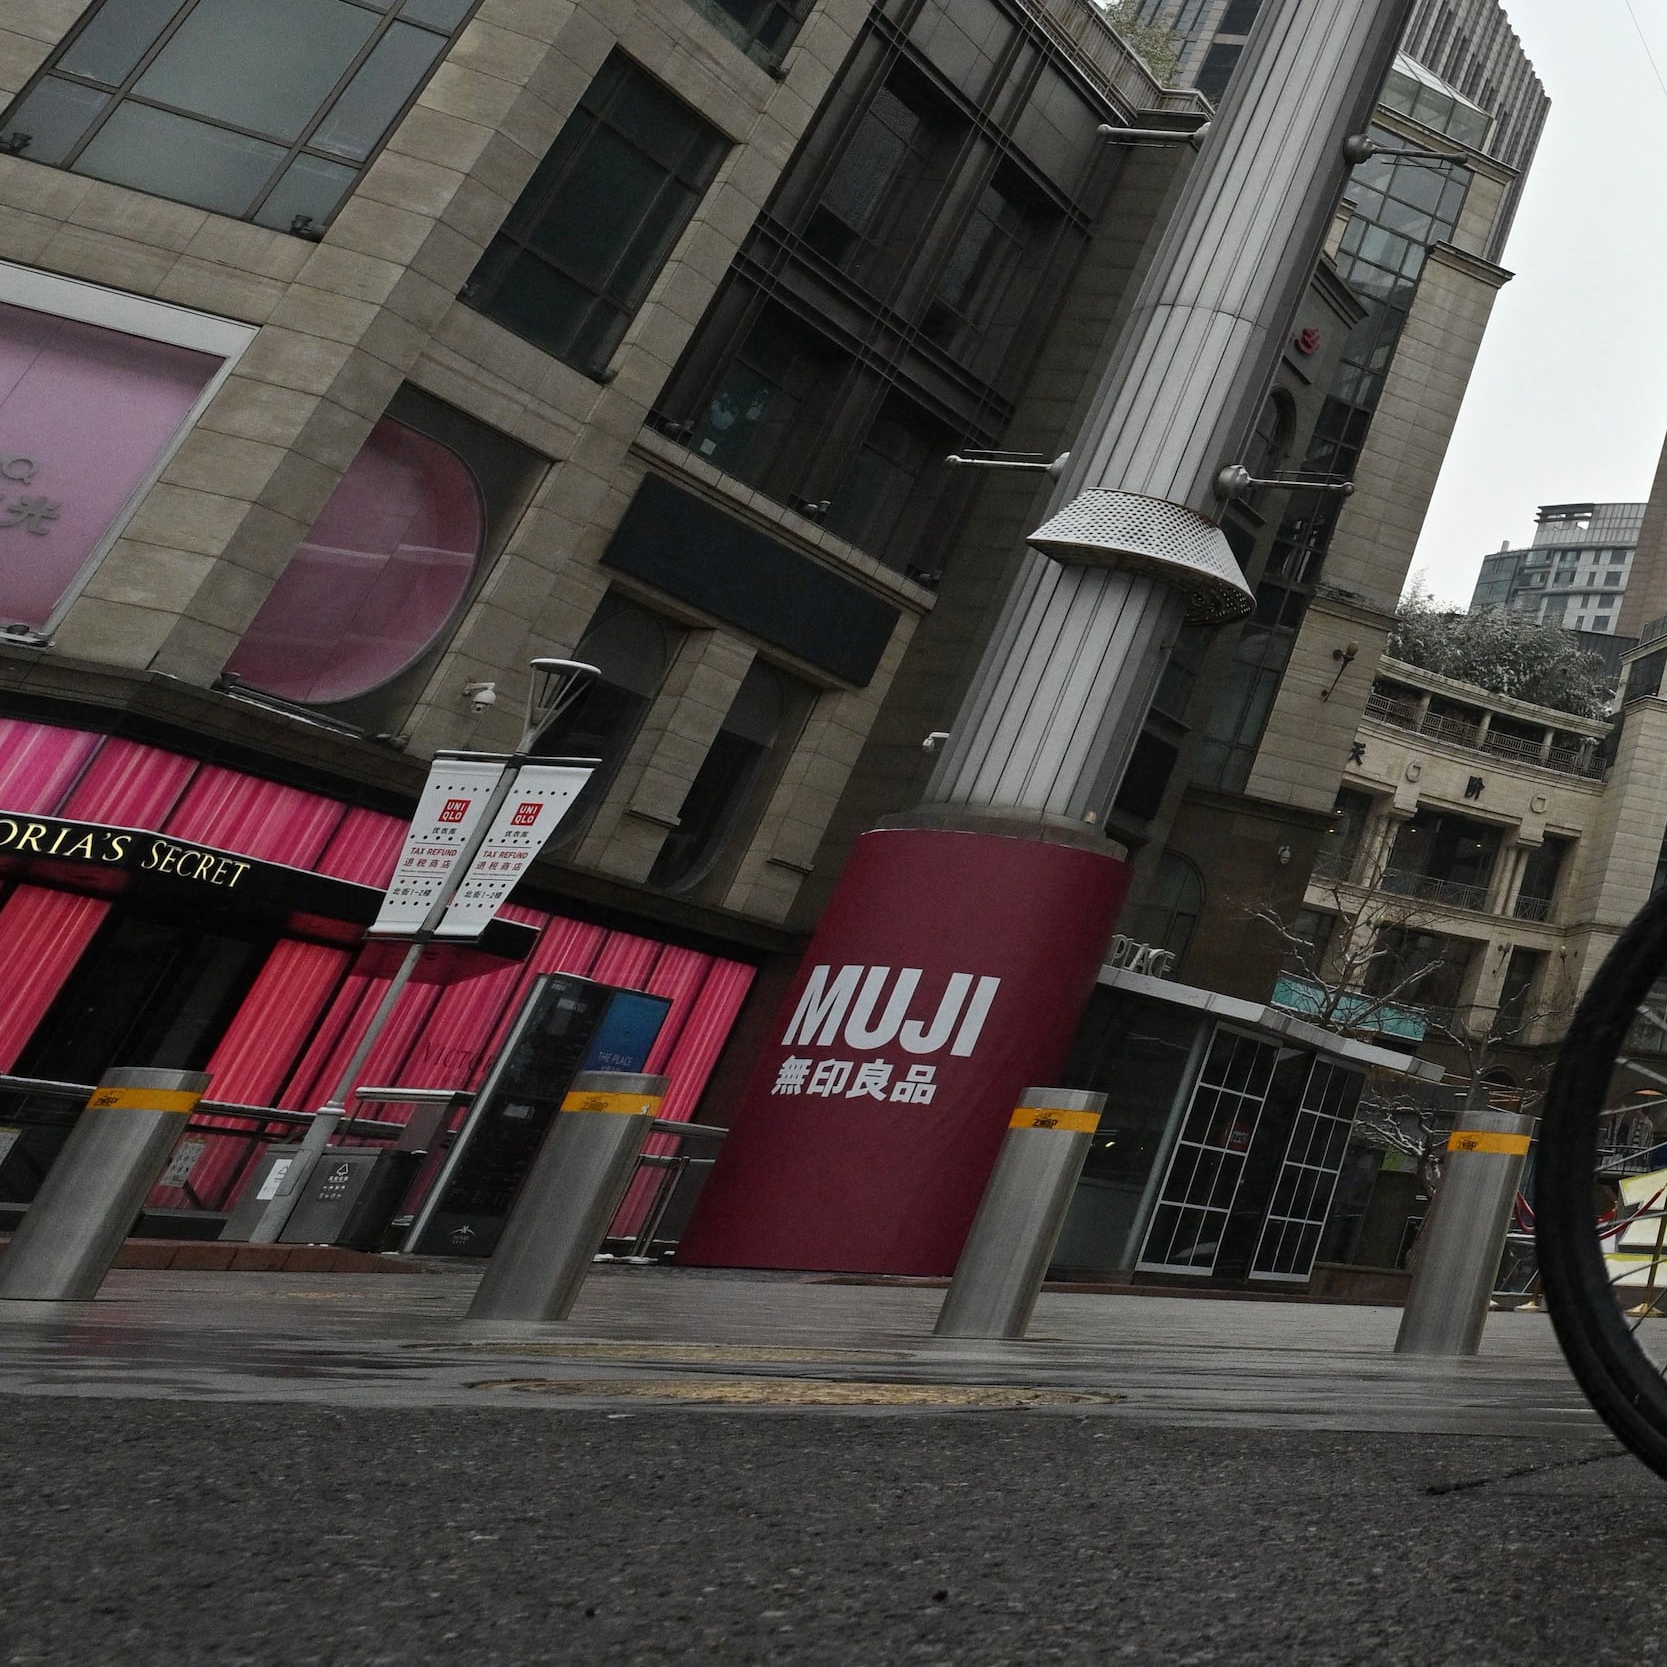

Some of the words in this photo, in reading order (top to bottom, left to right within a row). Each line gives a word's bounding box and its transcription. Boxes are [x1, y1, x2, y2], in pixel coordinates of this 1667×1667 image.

[446, 801, 466, 811] UNI
[519, 805, 539, 815] UNI
[442, 811, 463, 821] QLO
[514, 815, 535, 824] QLO
[410, 847, 426, 855] TAX
[427, 848, 458, 857] REFUND
[482, 850, 498, 858] TAX
[499, 851, 529, 860] REFUND
[141, 839, 251, 888] SECRET
[403, 857, 453, 869] 退税商店
[475, 861, 523, 872] 退税商店
[781, 964, 1002, 1058] MUJI
[771, 1055, 938, 1105] 無印良品
